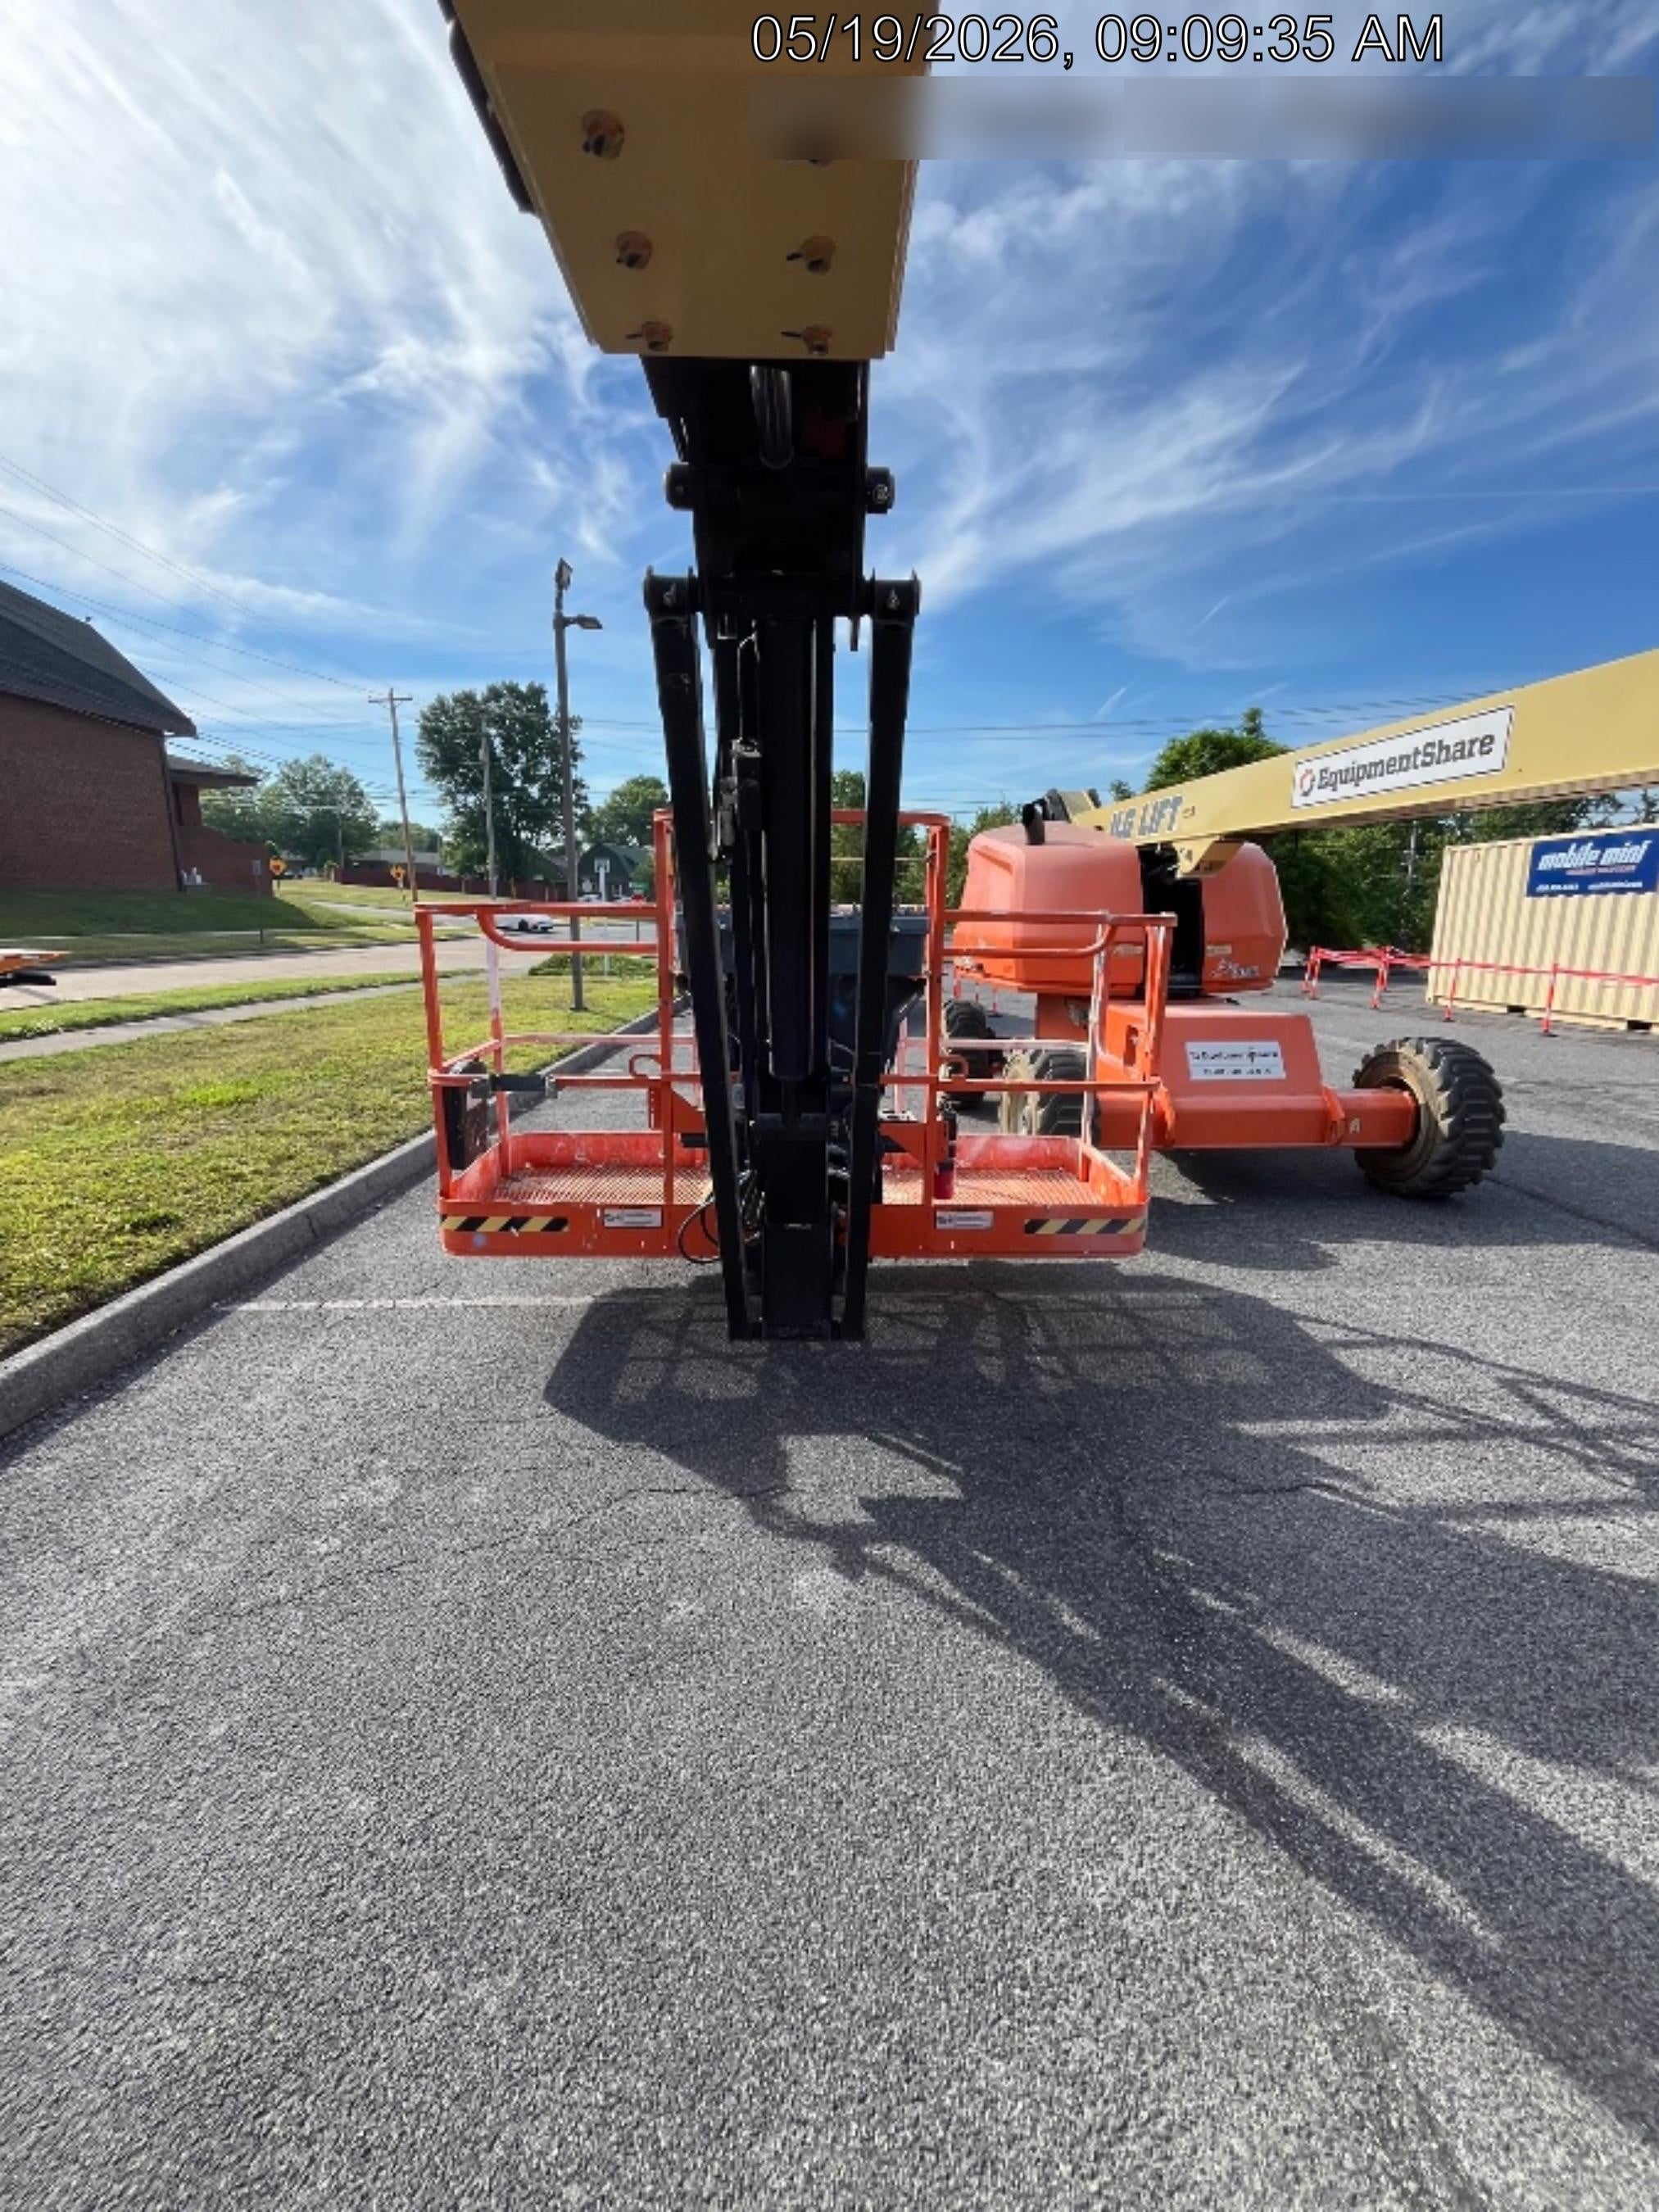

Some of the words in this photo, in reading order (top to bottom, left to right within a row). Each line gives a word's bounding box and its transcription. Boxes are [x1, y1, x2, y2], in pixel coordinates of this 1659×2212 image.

[1317, 733, 1495, 791] EquipmentShare
[1138, 796, 1183, 836] LIFT
[1536, 841, 1601, 870] mobile
[1599, 840, 1652, 865] mini
